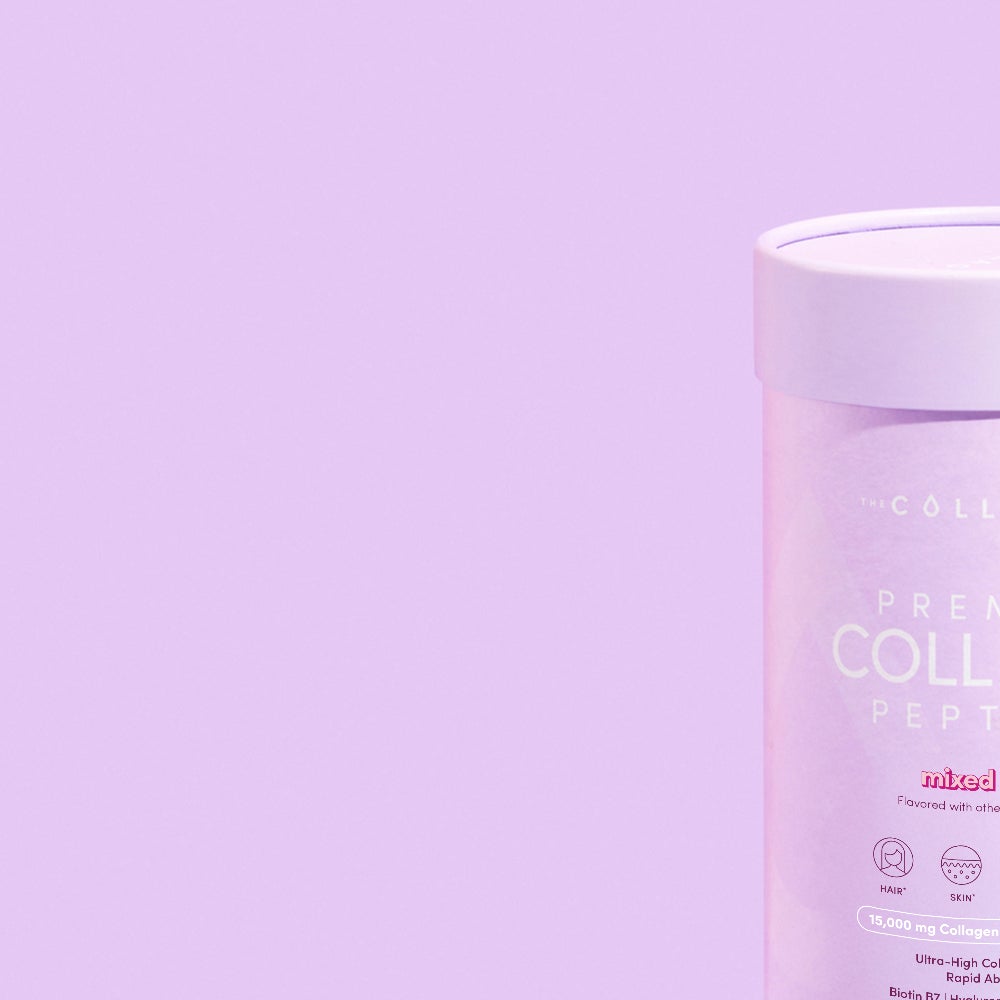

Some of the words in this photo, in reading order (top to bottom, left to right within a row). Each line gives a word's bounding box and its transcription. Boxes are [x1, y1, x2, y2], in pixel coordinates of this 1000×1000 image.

[921, 767, 996, 791] mixed
[897, 795, 946, 810] Flavored
[950, 798, 973, 812] with
[868, 913, 912, 931] 15,000
[915, 921, 936, 936] mg
[939, 923, 999, 939] Collagen
[915, 953, 978, 970] Ultra-High
[946, 972, 981, 985] Rapid
